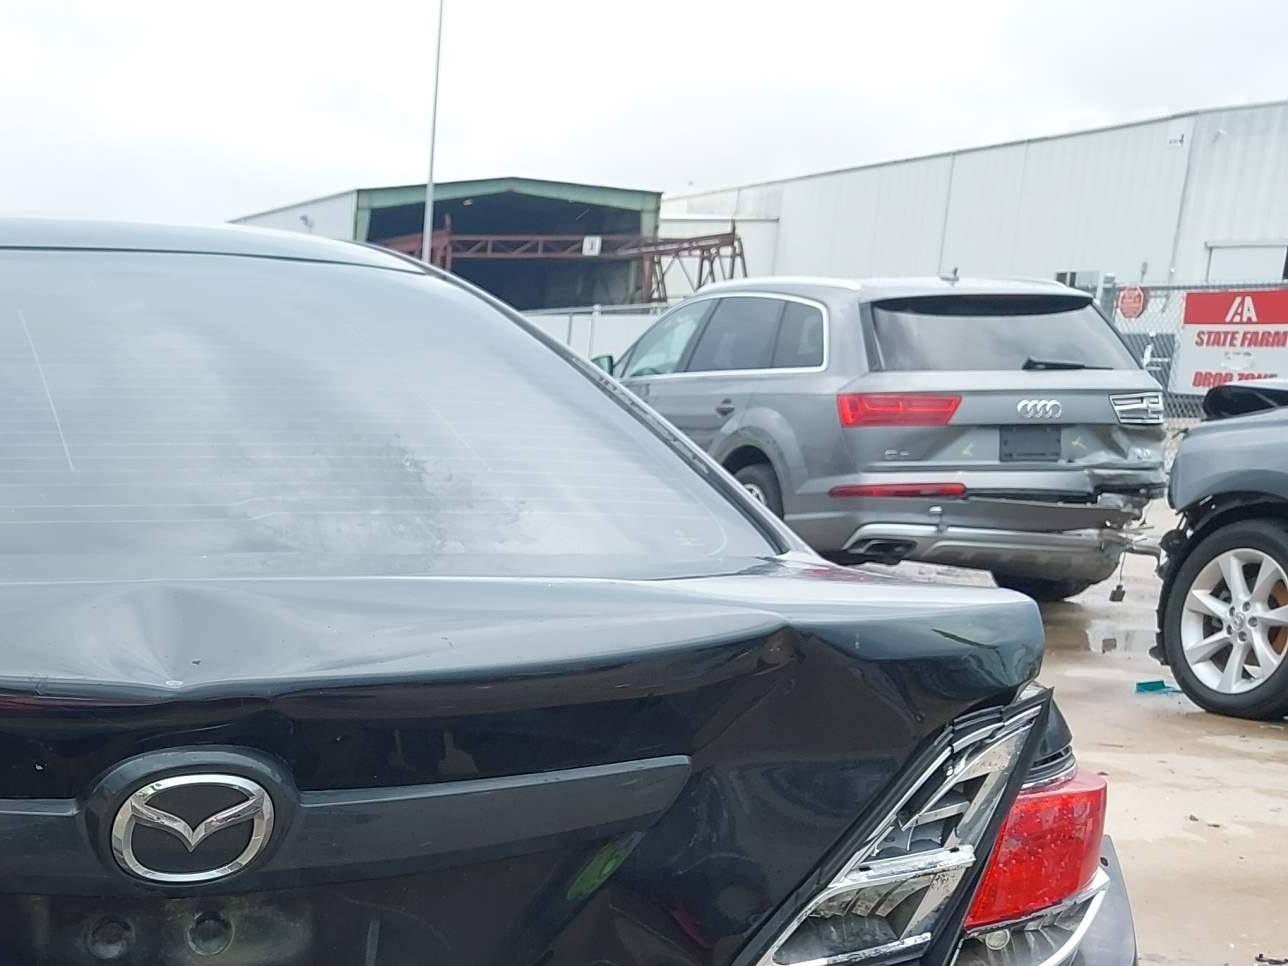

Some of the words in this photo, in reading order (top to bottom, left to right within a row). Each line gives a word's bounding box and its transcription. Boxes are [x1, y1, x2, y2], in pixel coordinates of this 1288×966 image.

[1195, 330, 1239, 347] STATE
[1240, 330, 1288, 347] FARM
[1192, 371, 1234, 387] DROP
